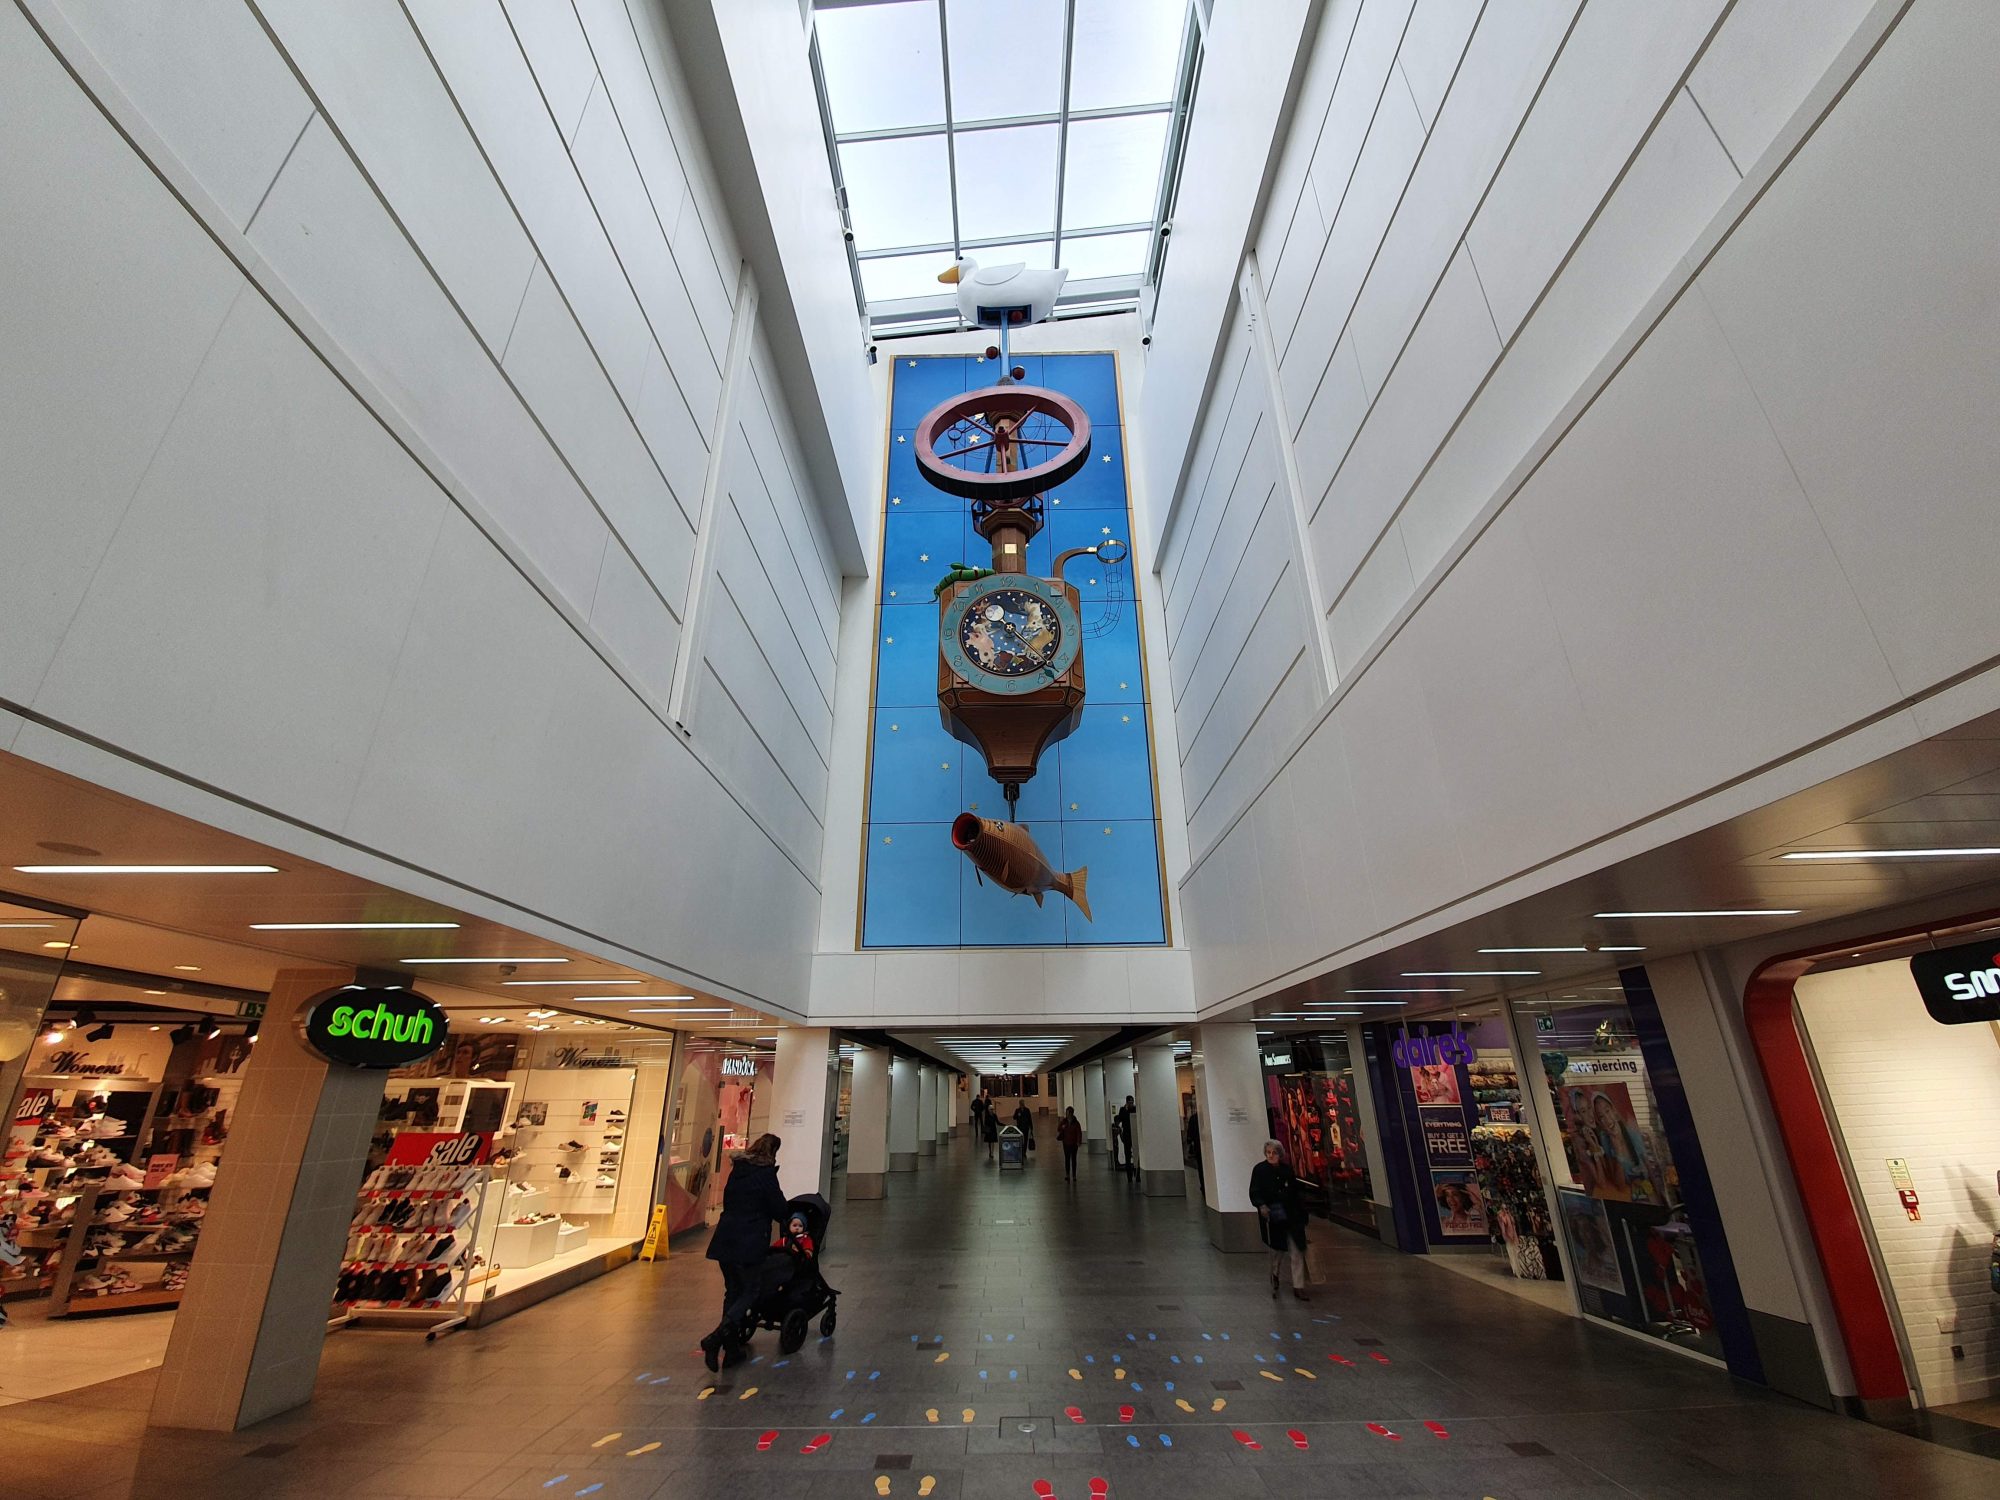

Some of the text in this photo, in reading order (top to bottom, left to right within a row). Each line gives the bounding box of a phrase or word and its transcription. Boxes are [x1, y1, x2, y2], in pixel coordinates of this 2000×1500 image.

[1001, 576, 1016, 588] 12
[327, 1003, 434, 1044] schuh
[1393, 1020, 1474, 1068] claire's
[50, 1051, 125, 1075] Womens
[1591, 1058, 1638, 1074] piercing
[425, 1132, 480, 1166] sale
[1428, 1138, 1468, 1154] FREE
